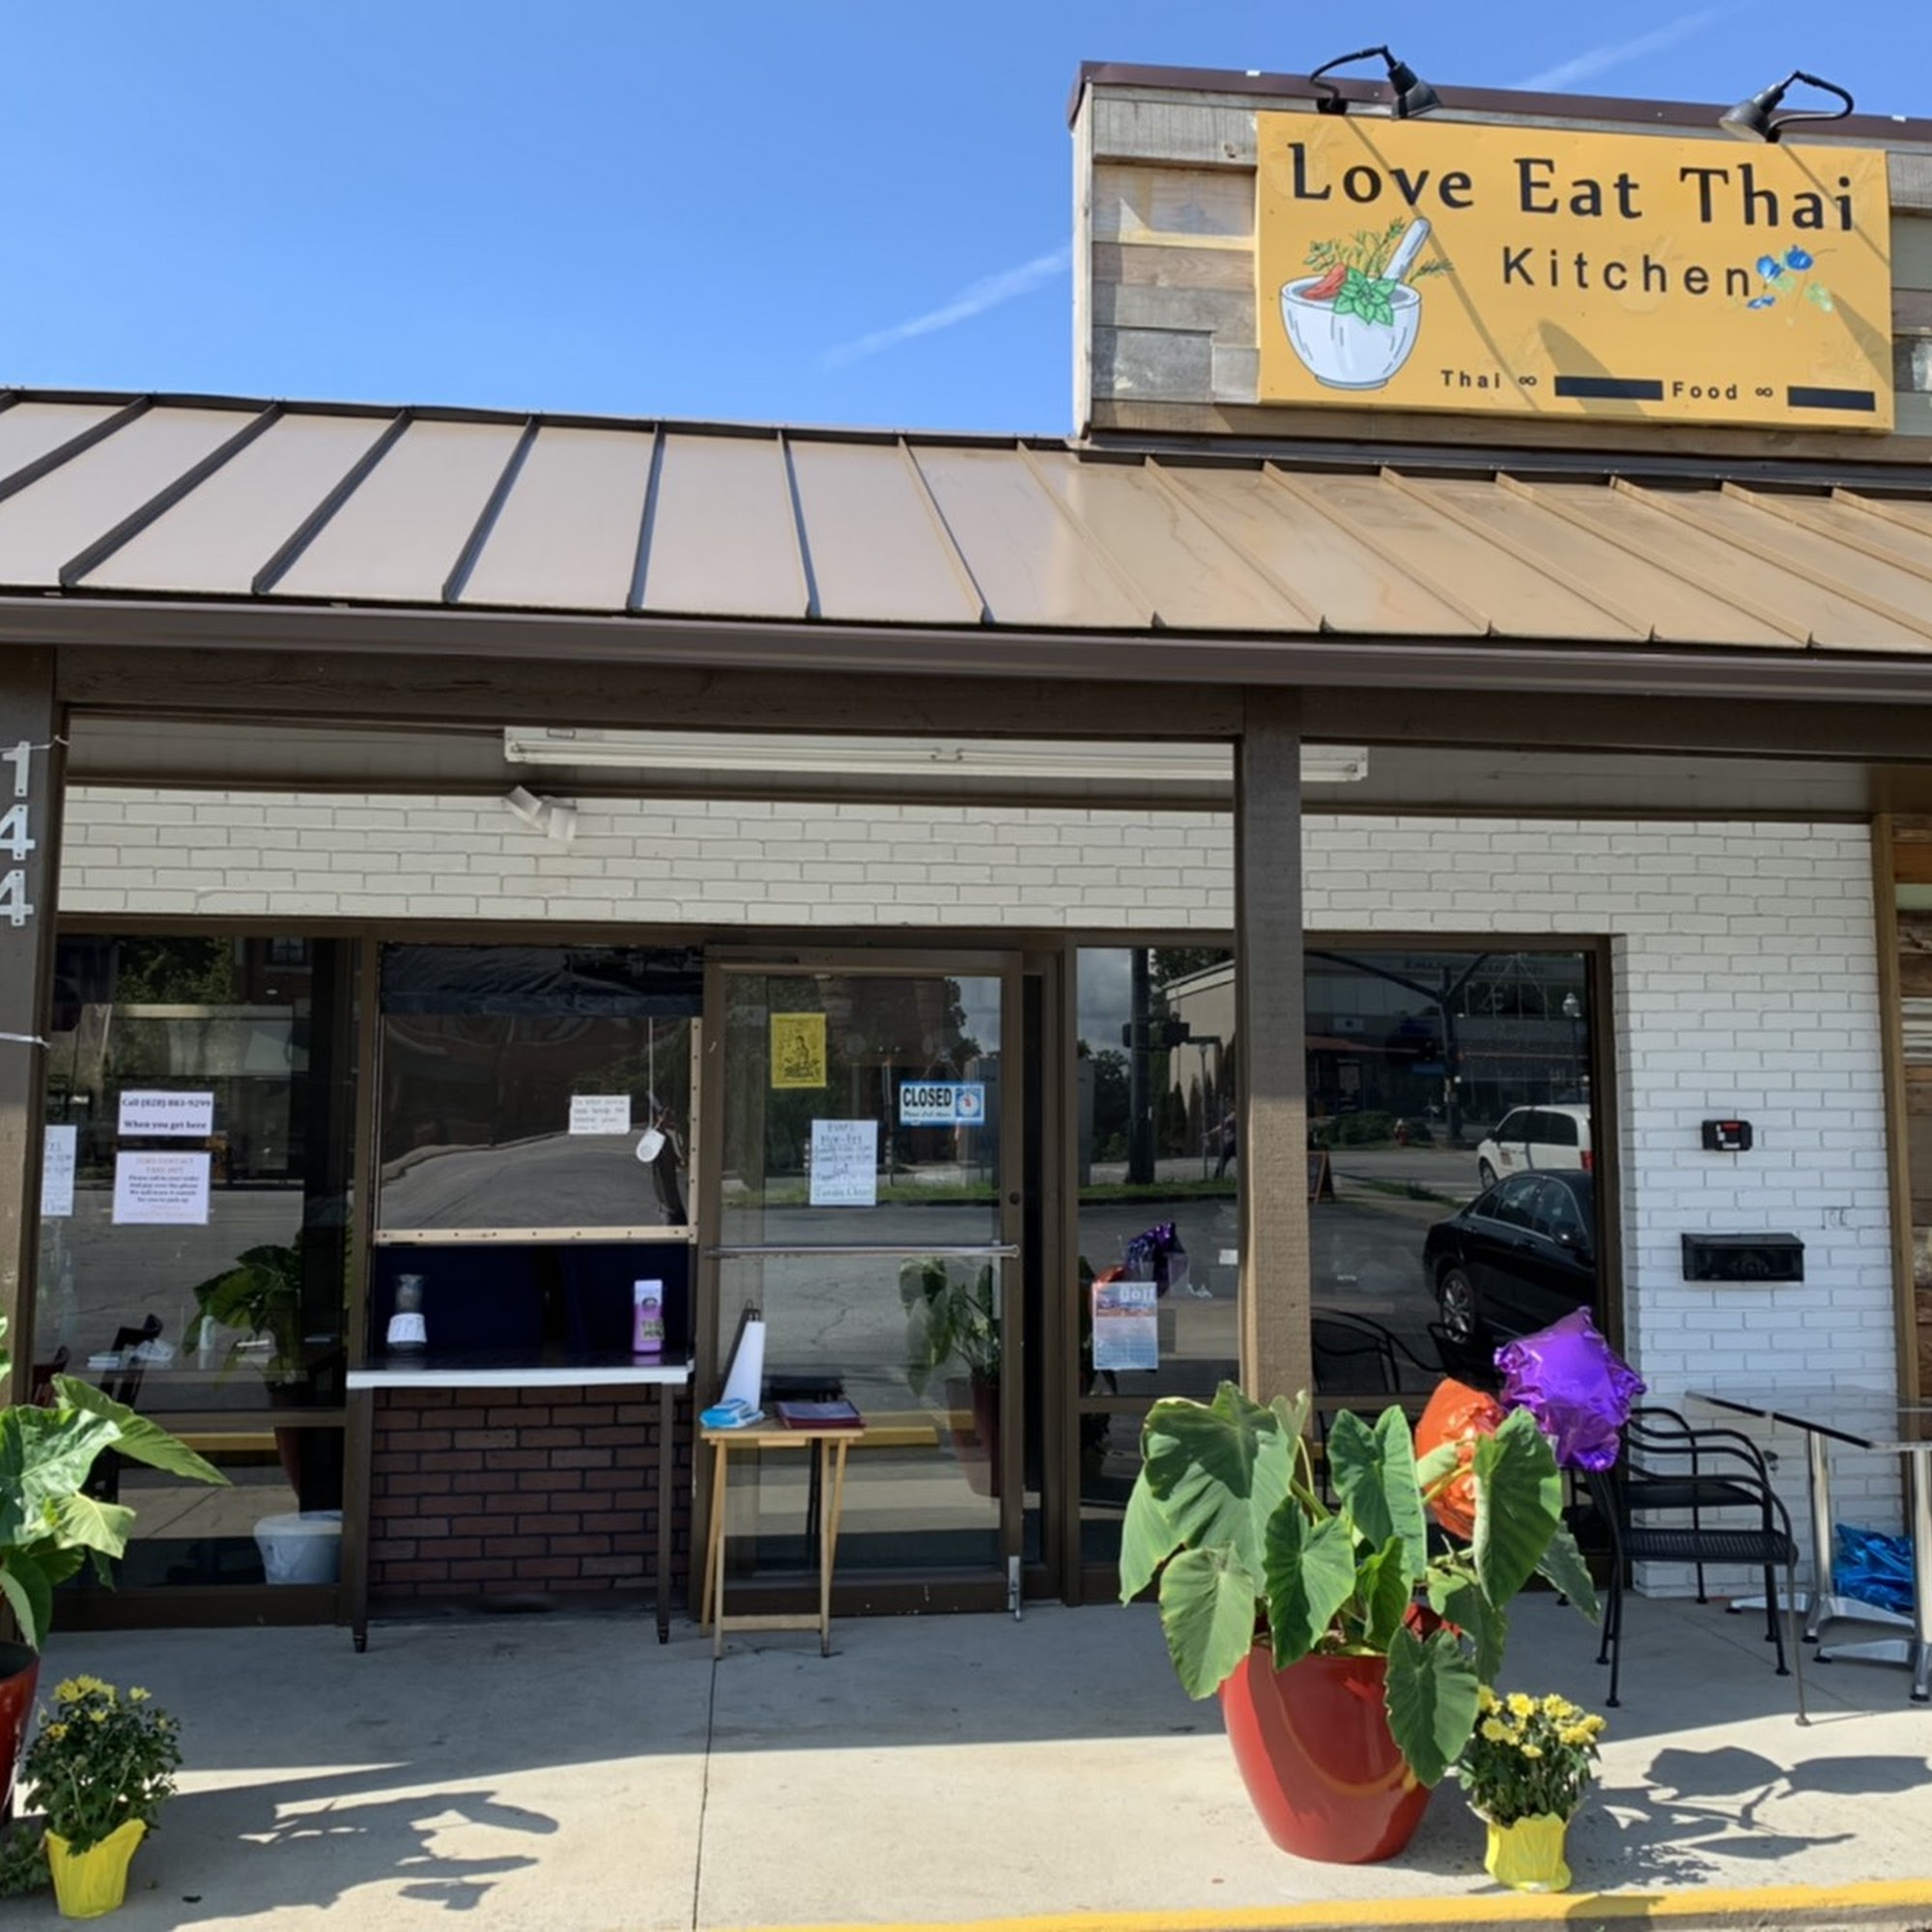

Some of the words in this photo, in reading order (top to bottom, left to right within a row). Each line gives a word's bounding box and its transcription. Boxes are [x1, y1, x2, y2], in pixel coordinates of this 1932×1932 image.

[1287, 142, 1473, 209] Love
[1514, 157, 1642, 219] Eat
[1680, 163, 1852, 231] Thai
[1503, 246, 1749, 297] Kitchen
[1441, 369, 1500, 388] Thai
[1672, 381, 1738, 400] Food
[903, 1087, 952, 1107] CLOSED
[124, 1120, 150, 1128] When
[170, 1122, 184, 1130] get
